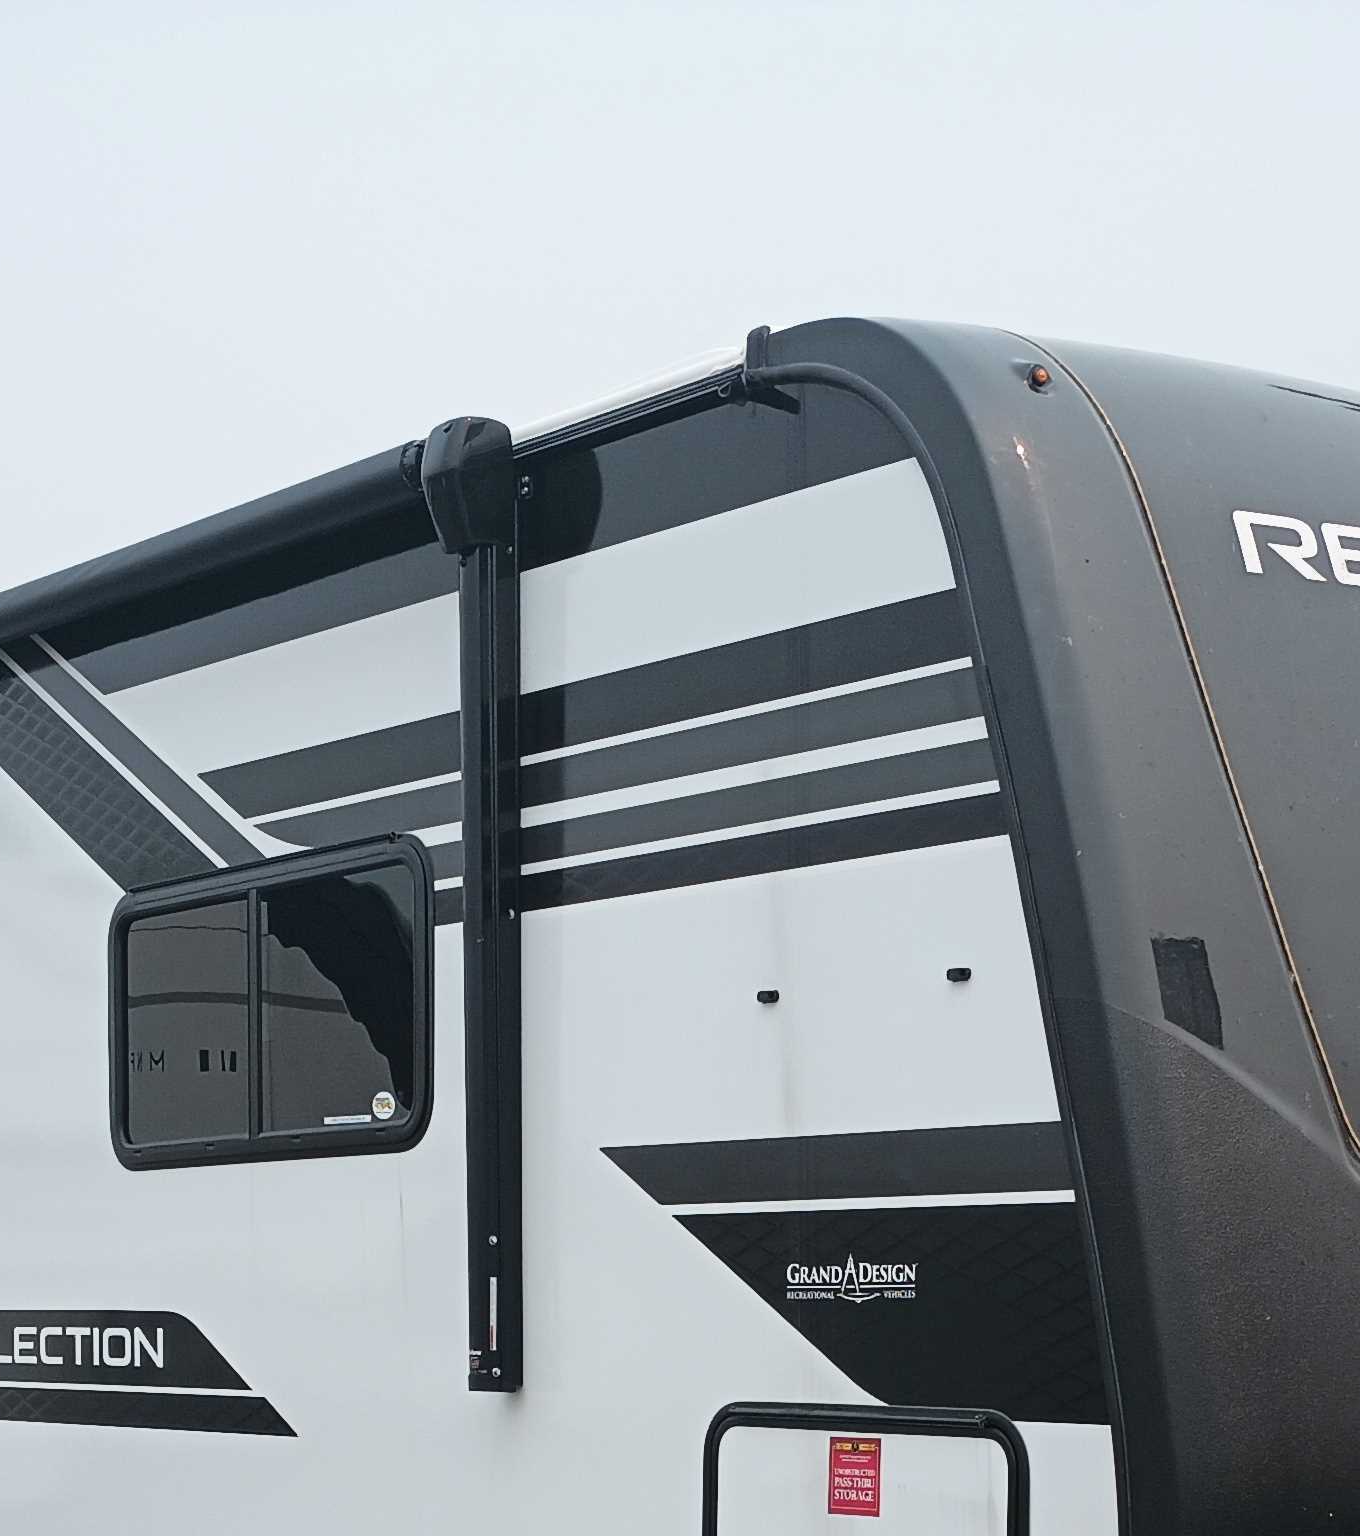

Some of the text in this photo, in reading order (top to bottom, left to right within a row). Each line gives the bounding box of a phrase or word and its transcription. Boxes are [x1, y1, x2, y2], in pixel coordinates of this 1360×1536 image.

[786, 1262, 916, 1284] GRAND DESIGN
[834, 1488, 875, 1502] STORAGE
